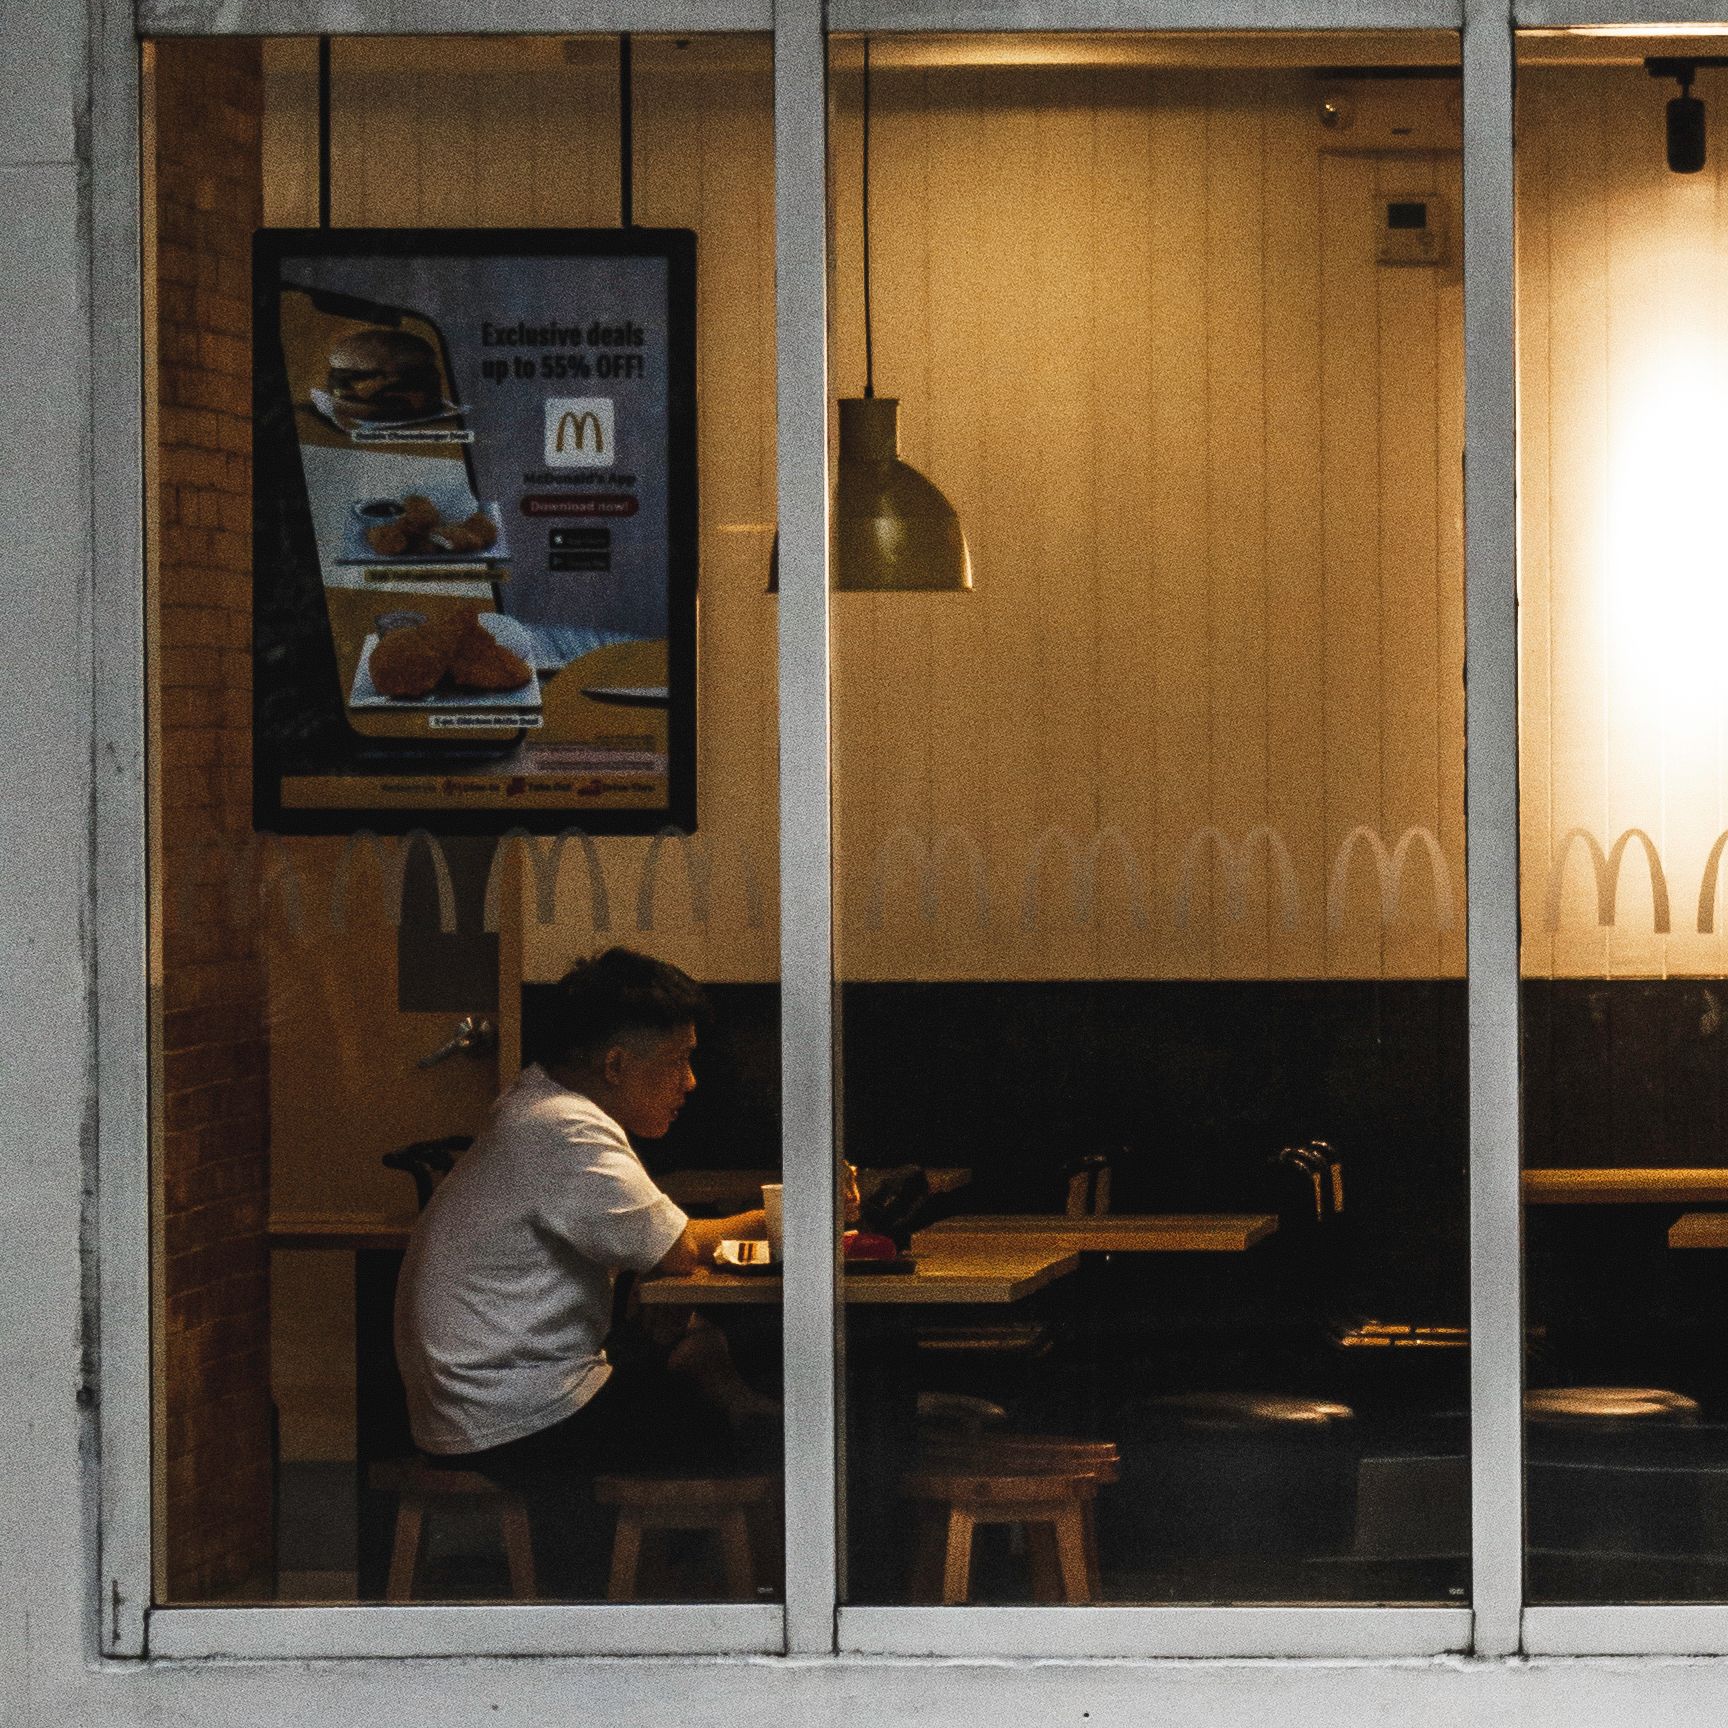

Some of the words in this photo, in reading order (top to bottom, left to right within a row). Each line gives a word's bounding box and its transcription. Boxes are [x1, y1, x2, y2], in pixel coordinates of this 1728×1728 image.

[482, 321, 581, 347] Exclusive
[587, 321, 643, 347] deals
[482, 358, 509, 386] up
[514, 355, 536, 379] to
[541, 354, 590, 379] 55%
[596, 353, 643, 379] OFF!
[523, 472, 605, 485] McDonald's
[608, 472, 637, 487] App
[530, 499, 596, 513] Download
[598, 499, 630, 513] now!
